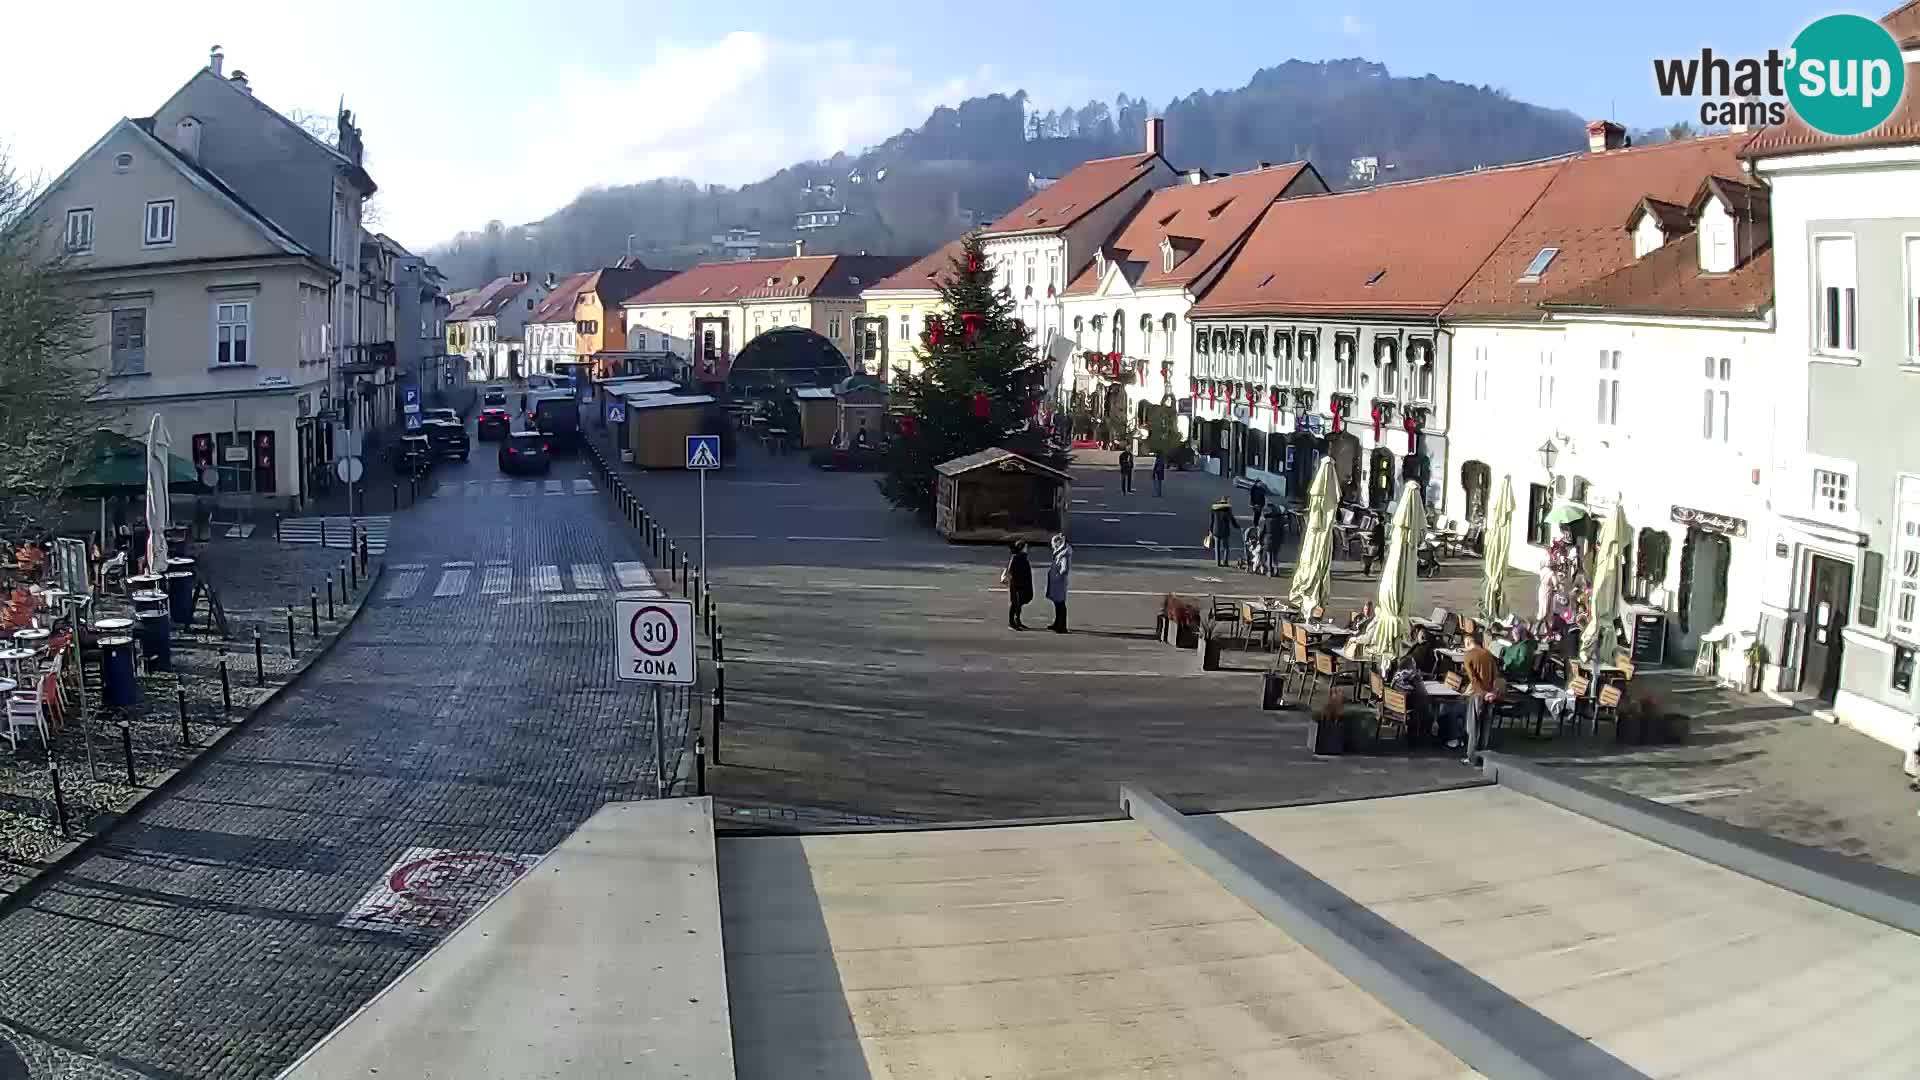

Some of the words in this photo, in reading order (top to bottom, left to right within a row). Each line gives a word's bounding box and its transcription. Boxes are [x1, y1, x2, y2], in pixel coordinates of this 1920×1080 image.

[407, 391, 416, 402] P
[643, 622, 667, 643] 30
[633, 659, 678, 676] ZONA
